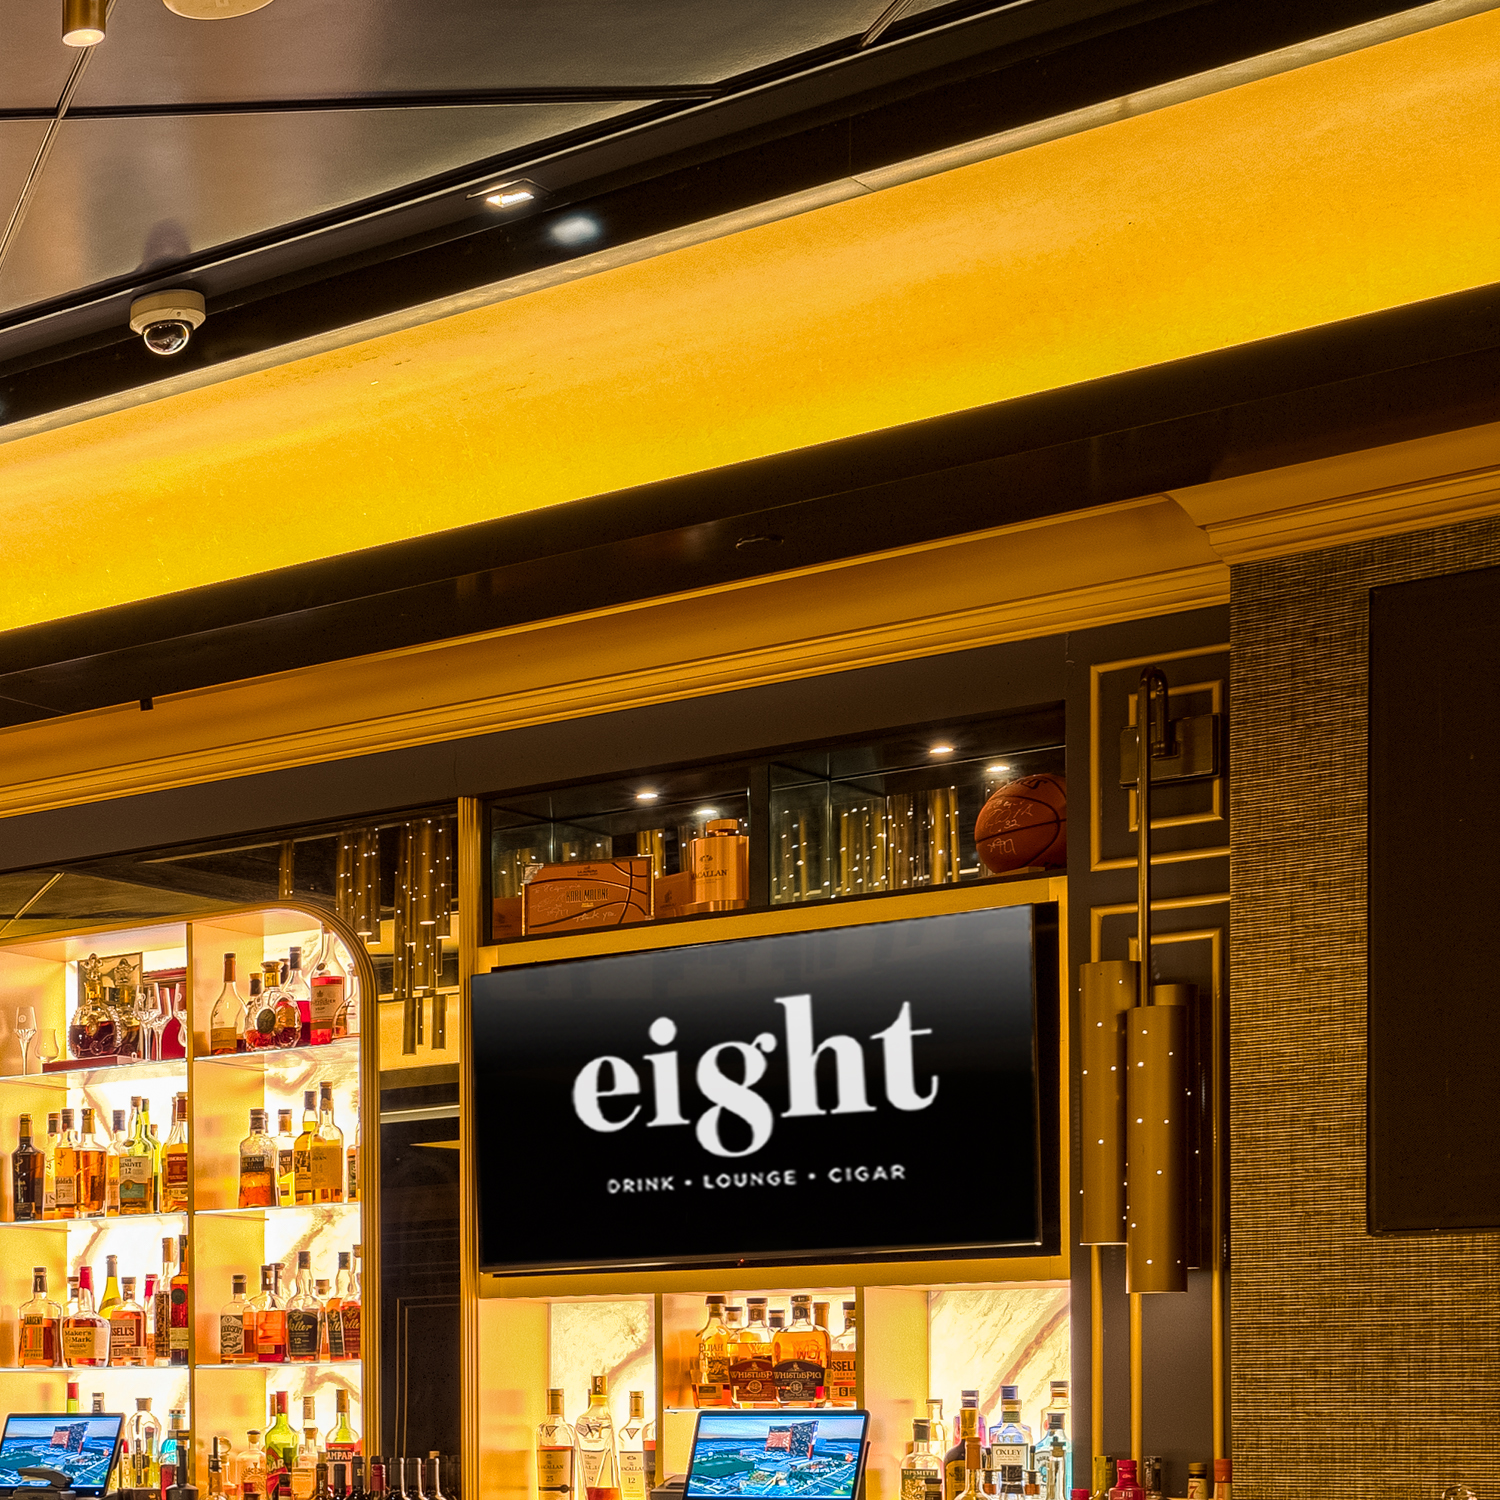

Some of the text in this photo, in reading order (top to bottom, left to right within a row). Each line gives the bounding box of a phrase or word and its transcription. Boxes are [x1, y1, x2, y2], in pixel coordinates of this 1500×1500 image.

[566, 888, 609, 903] KARL MALONE
[571, 993, 938, 1158] eight
[606, 1164, 905, 1194] DRINK LOUNGE CIGAR
[731, 1368, 773, 1379] WHISTLEP
[774, 1367, 822, 1379] WHISTLEPIG
[995, 1448, 1022, 1456] OXLEY
[1189, 1486, 1199, 1500] 7
